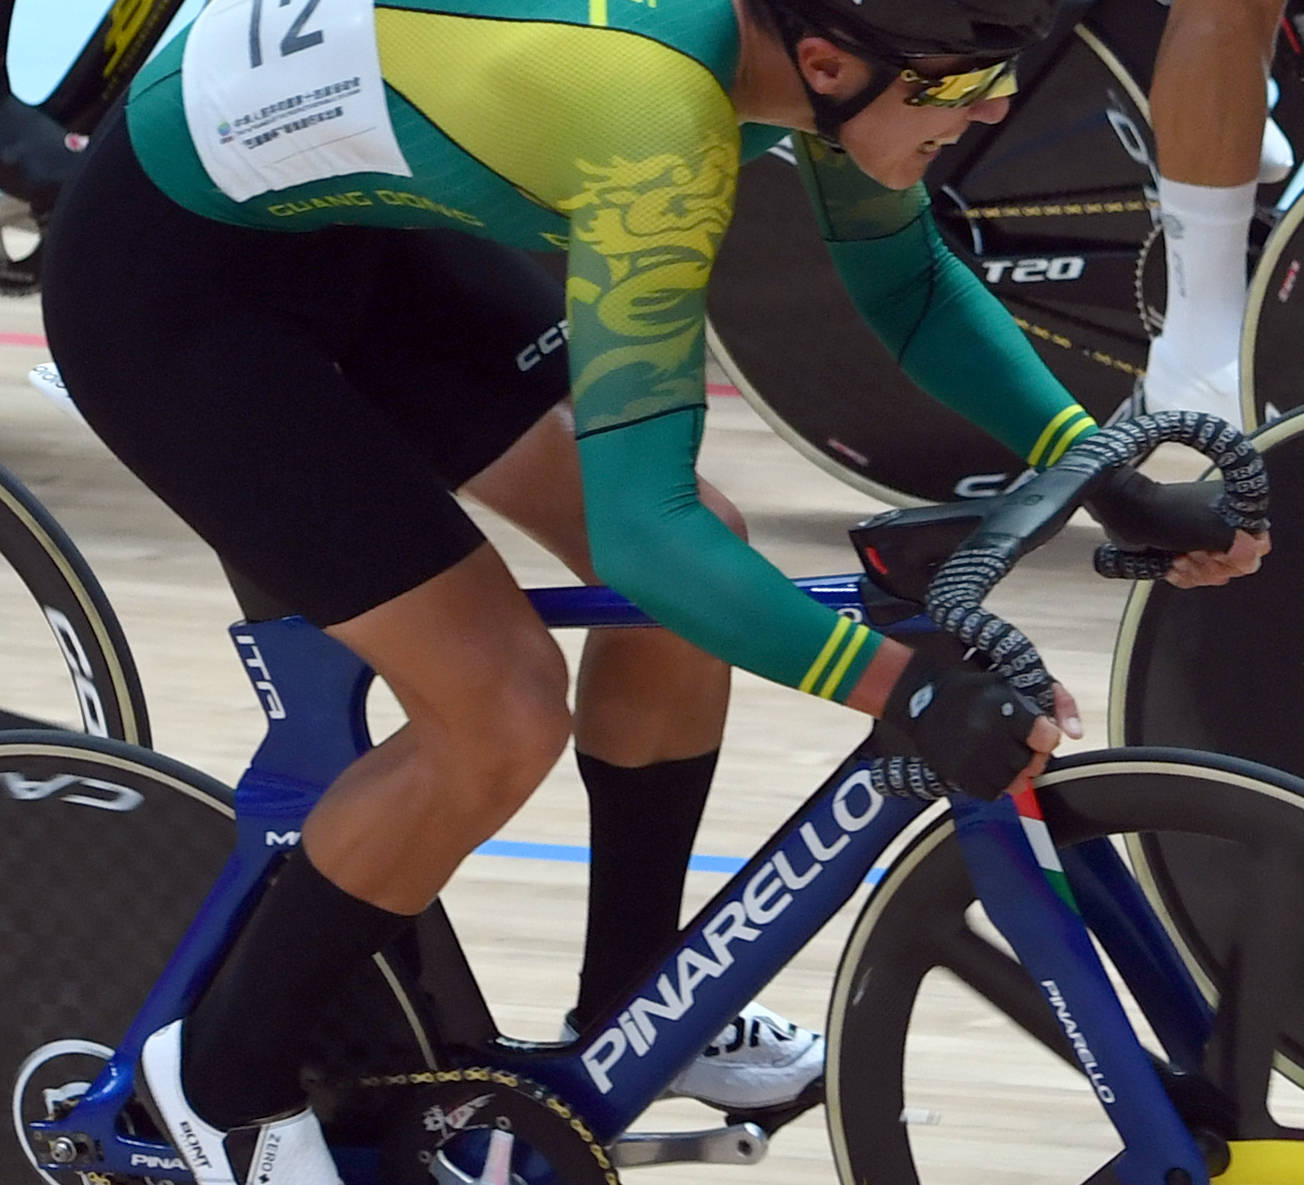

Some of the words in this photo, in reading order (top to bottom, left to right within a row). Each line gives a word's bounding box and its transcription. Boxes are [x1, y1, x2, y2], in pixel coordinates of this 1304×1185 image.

[268, 190, 373, 218] GUANG
[981, 256, 1086, 284] T20
[235, 634, 287, 720] ITA
[580, 769, 886, 1095] PINARELLO
[1040, 979, 1117, 1104] PINARELLO
[179, 1120, 213, 1170] BONT
